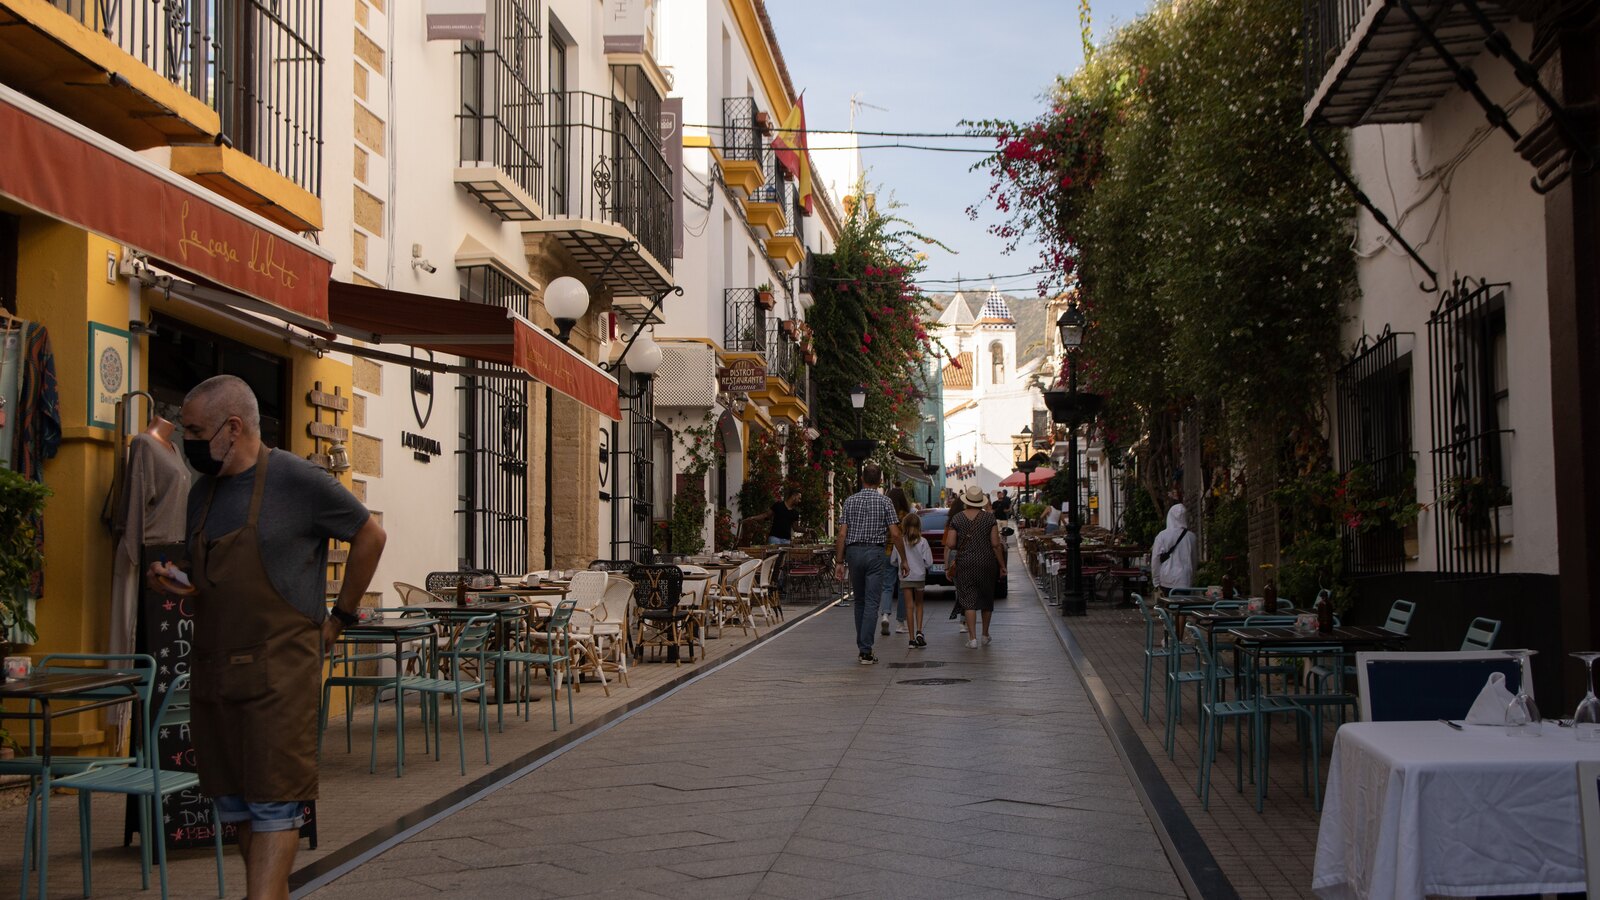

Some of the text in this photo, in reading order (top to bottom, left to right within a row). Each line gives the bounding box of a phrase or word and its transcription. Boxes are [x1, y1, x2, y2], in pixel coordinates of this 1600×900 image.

[179, 200, 211, 261] La
[208, 239, 239, 262] casa
[248, 230, 274, 279] del
[108, 257, 115, 278] 7
[729, 368, 755, 377] BISTROT
[721, 376, 764, 385] RESTAURANTE
